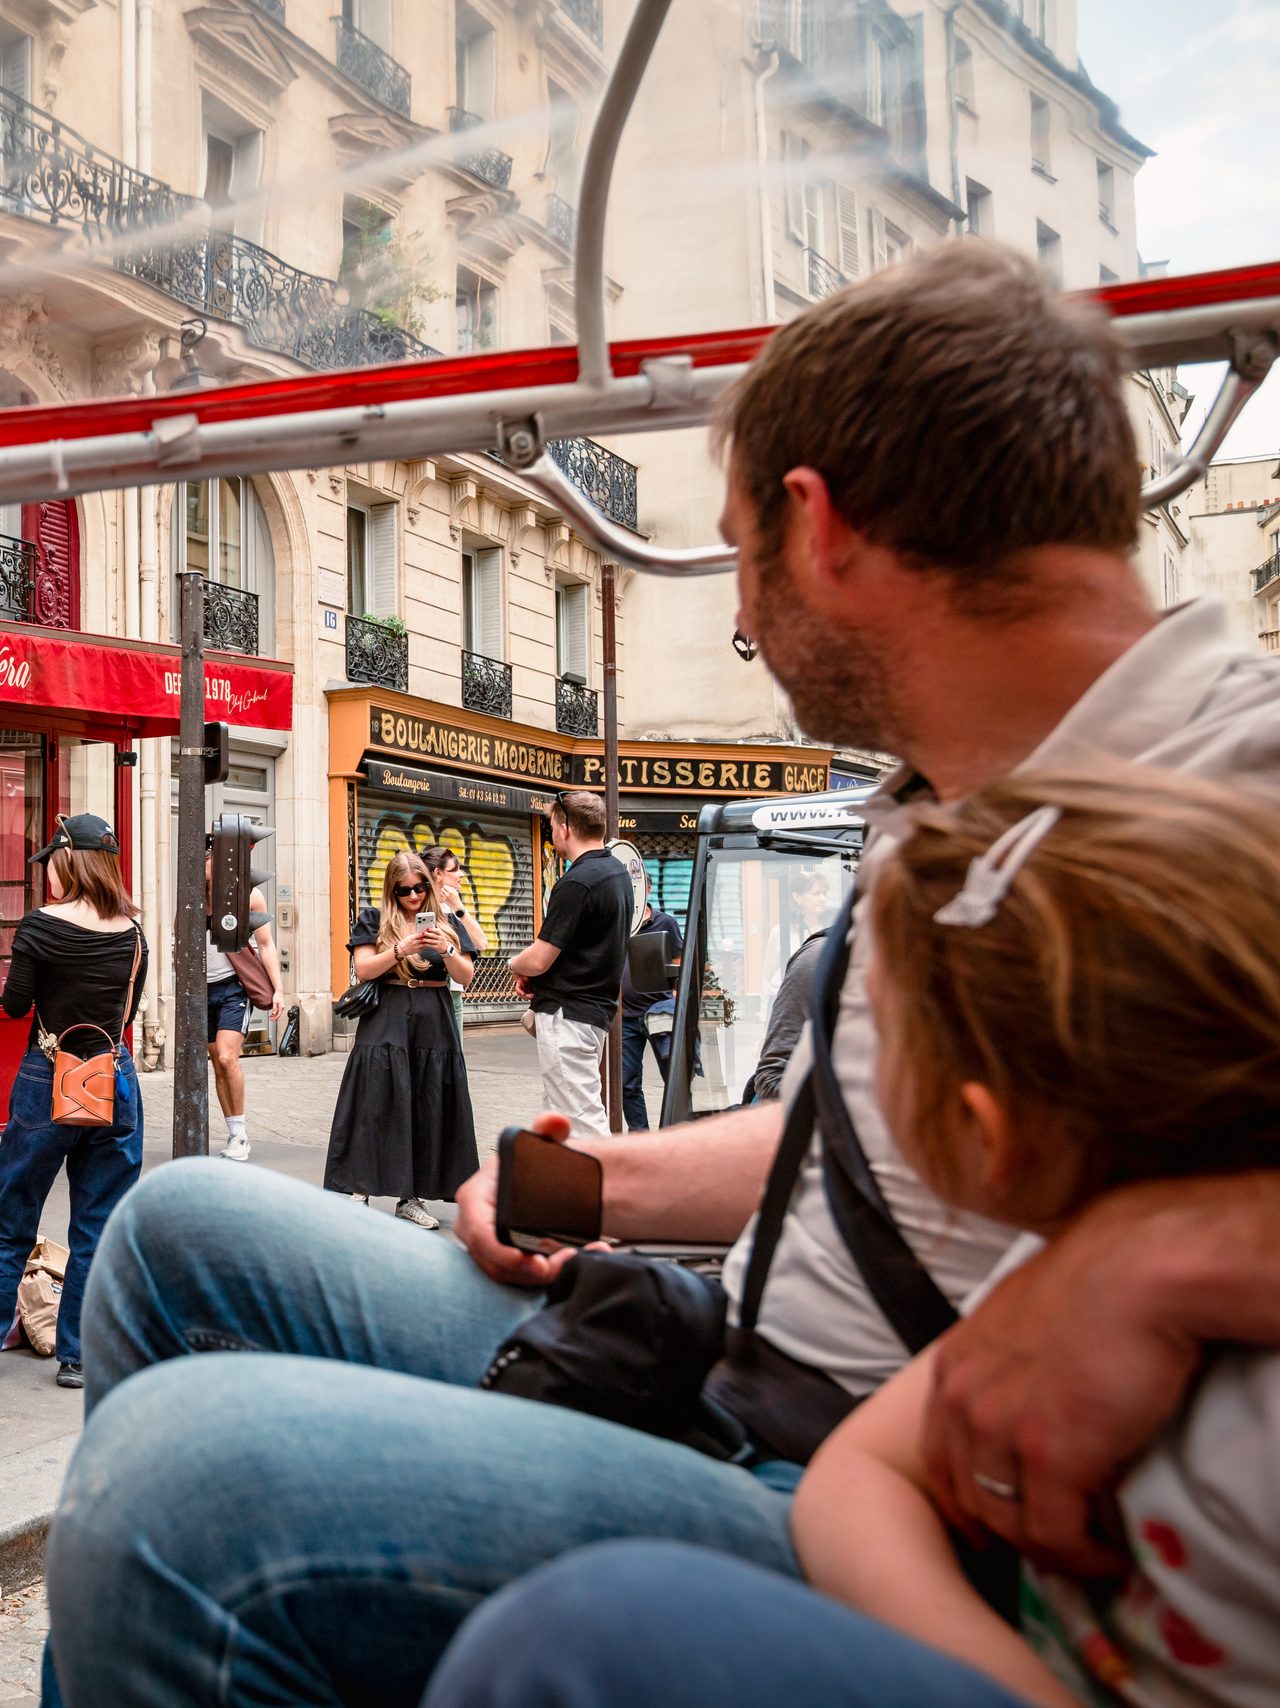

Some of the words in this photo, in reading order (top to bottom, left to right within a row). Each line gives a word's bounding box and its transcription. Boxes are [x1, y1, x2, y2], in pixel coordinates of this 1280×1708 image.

[326, 611, 336, 628] 16
[204, 677, 231, 702] 1978
[381, 712, 490, 766] BOULANGERIE
[494, 740, 564, 780] MODERNE
[382, 769, 431, 794] Boulangerie
[476, 789, 484, 801] 43
[618, 816, 637, 829] ine
[679, 814, 697, 829] Sa
